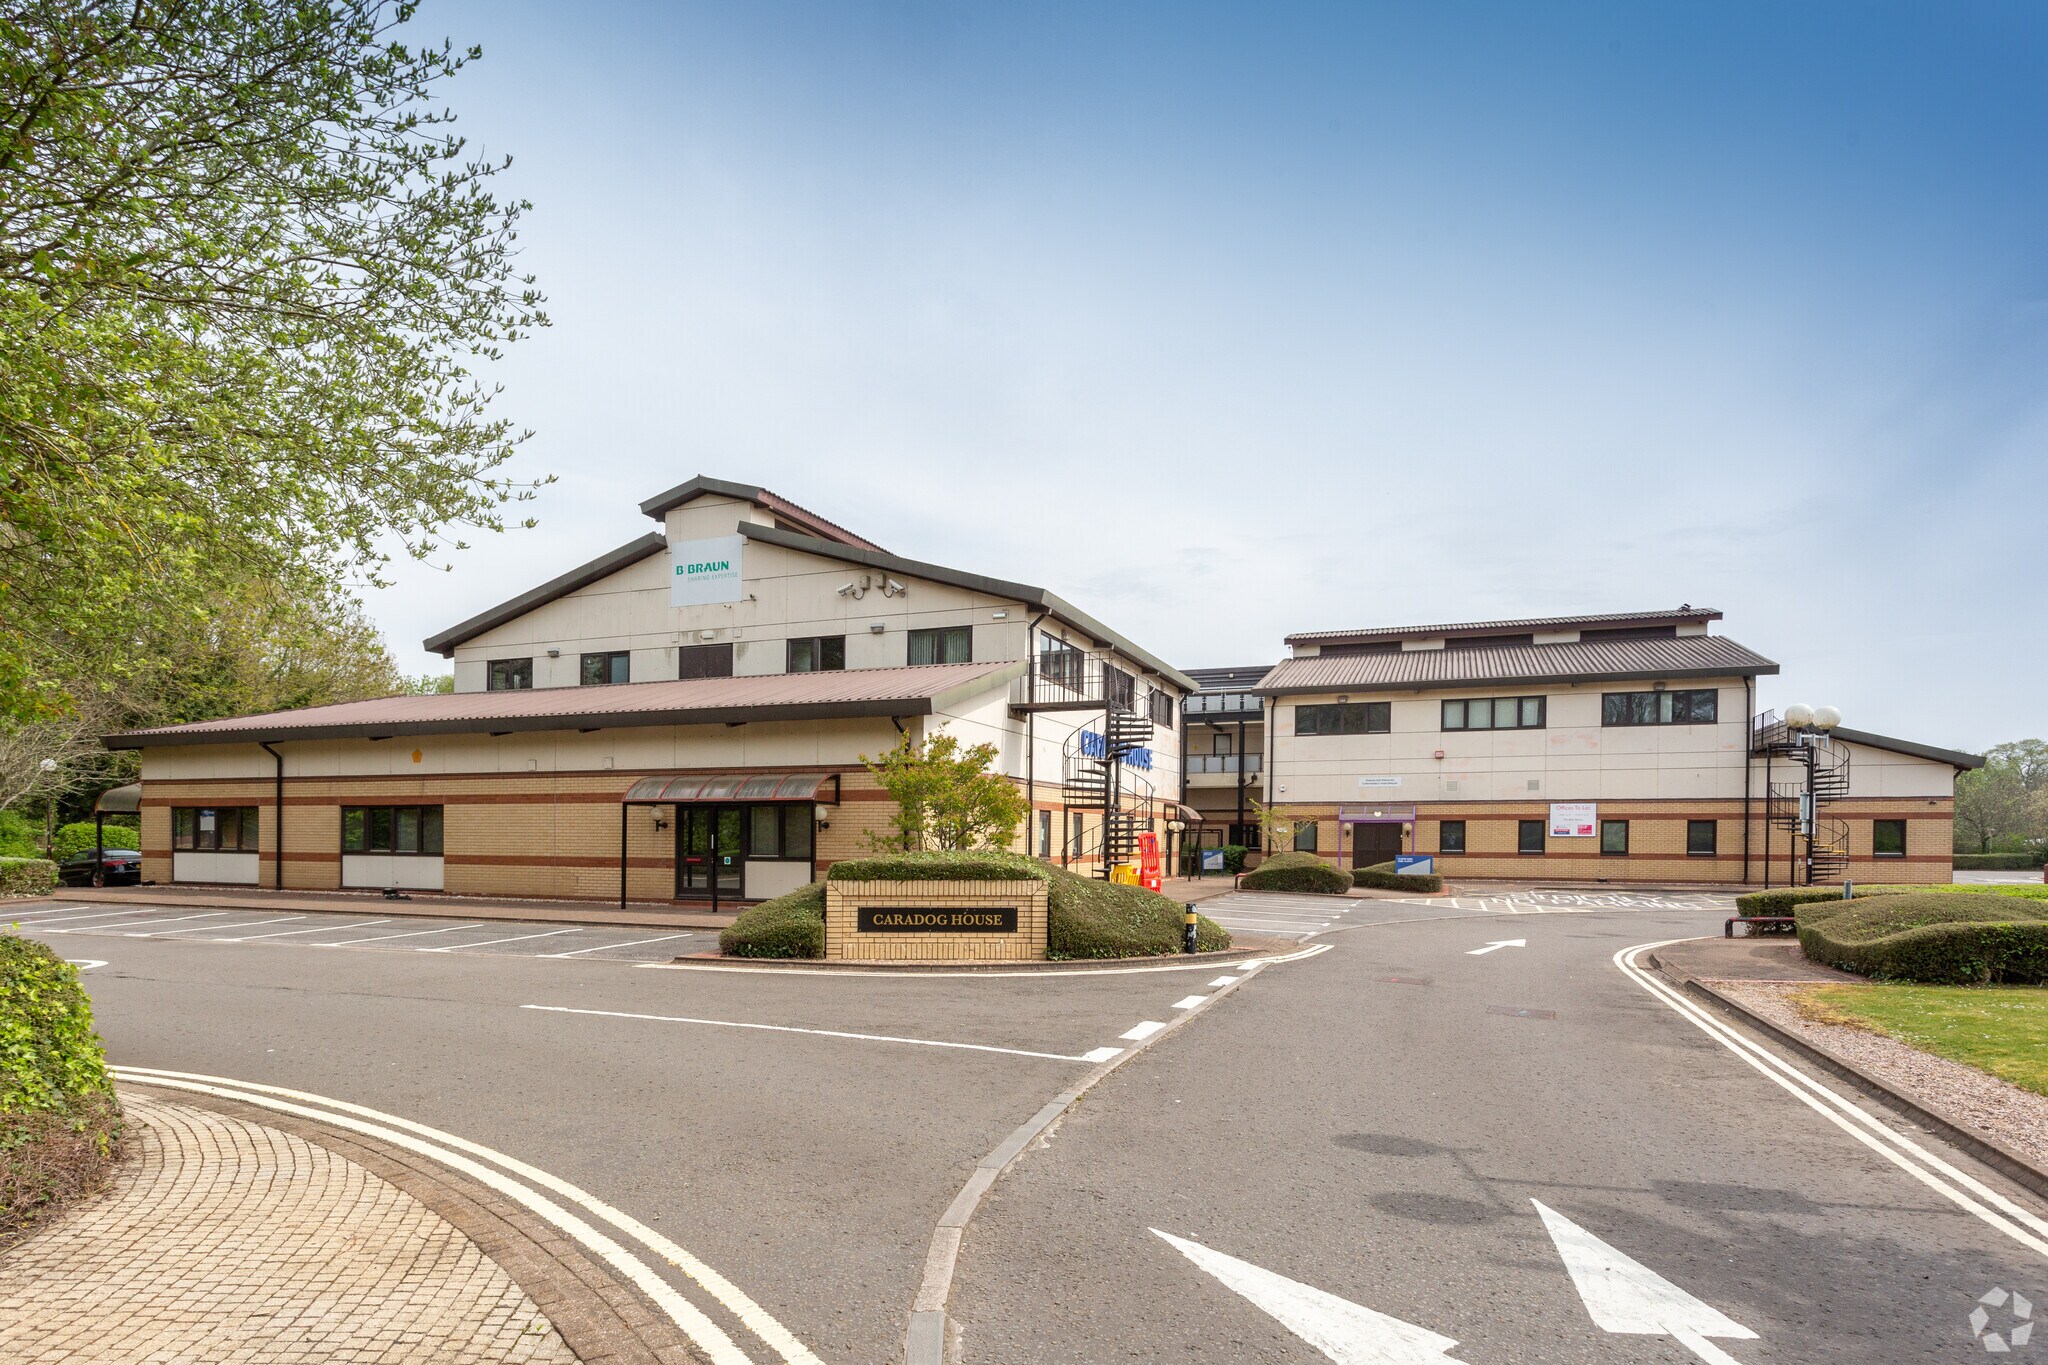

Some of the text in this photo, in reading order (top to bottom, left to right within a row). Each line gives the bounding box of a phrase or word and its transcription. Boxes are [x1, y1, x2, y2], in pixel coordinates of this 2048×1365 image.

[676, 561, 729, 575] B BRAUN
[687, 571, 738, 582] SHARING EXPERTISE
[873, 913, 1003, 926] CARADOG HOUSE
